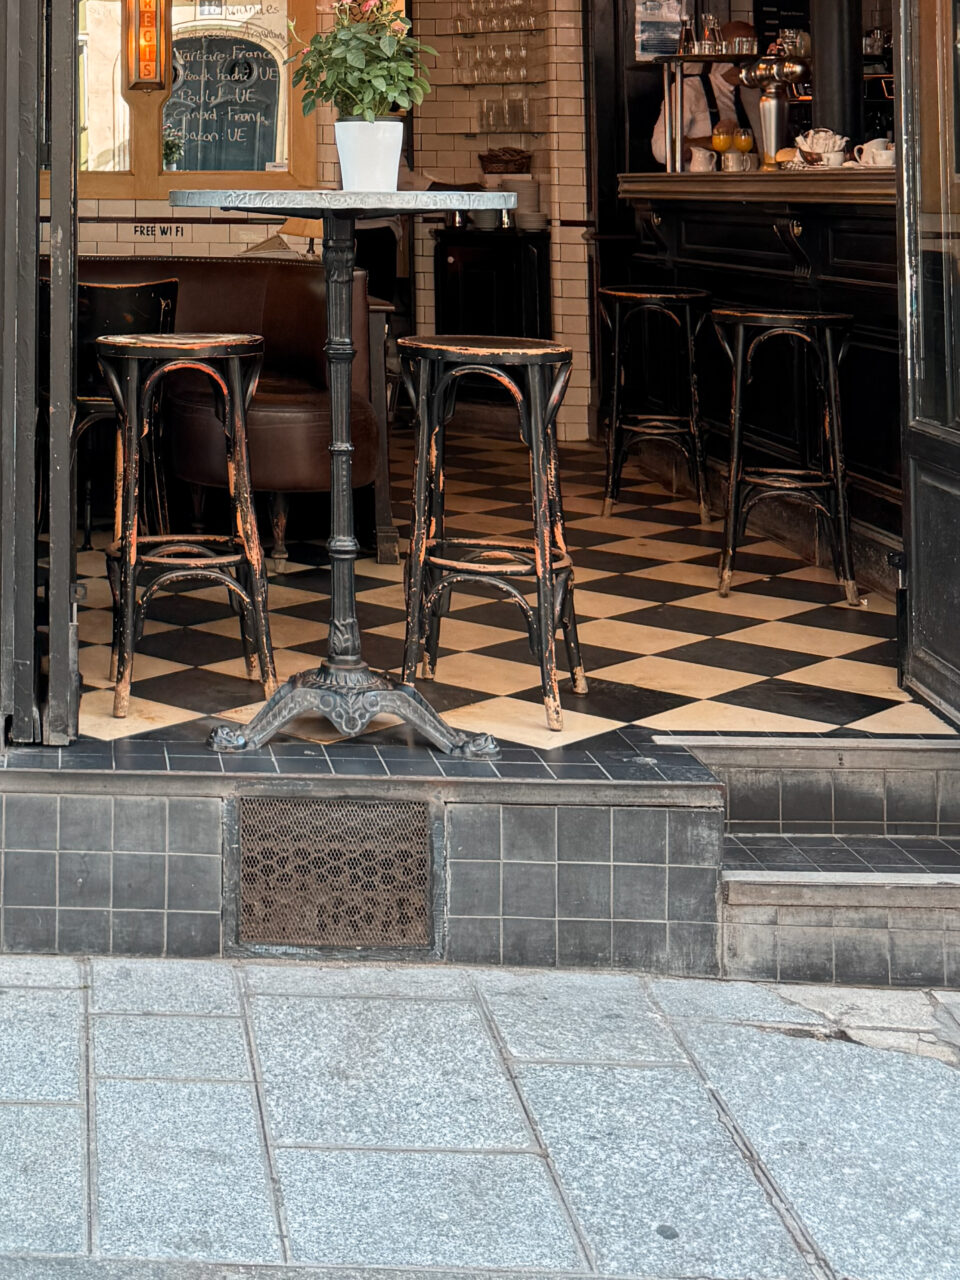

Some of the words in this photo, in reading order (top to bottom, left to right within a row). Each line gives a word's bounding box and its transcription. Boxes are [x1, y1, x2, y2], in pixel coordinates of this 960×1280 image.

[260, 66, 279, 80] UE
[236, 88, 256, 103] UE
[228, 128, 247, 142] UE
[134, 225, 156, 236] FREE
[160, 225, 172, 236] WI
[175, 225, 184, 237] FI
